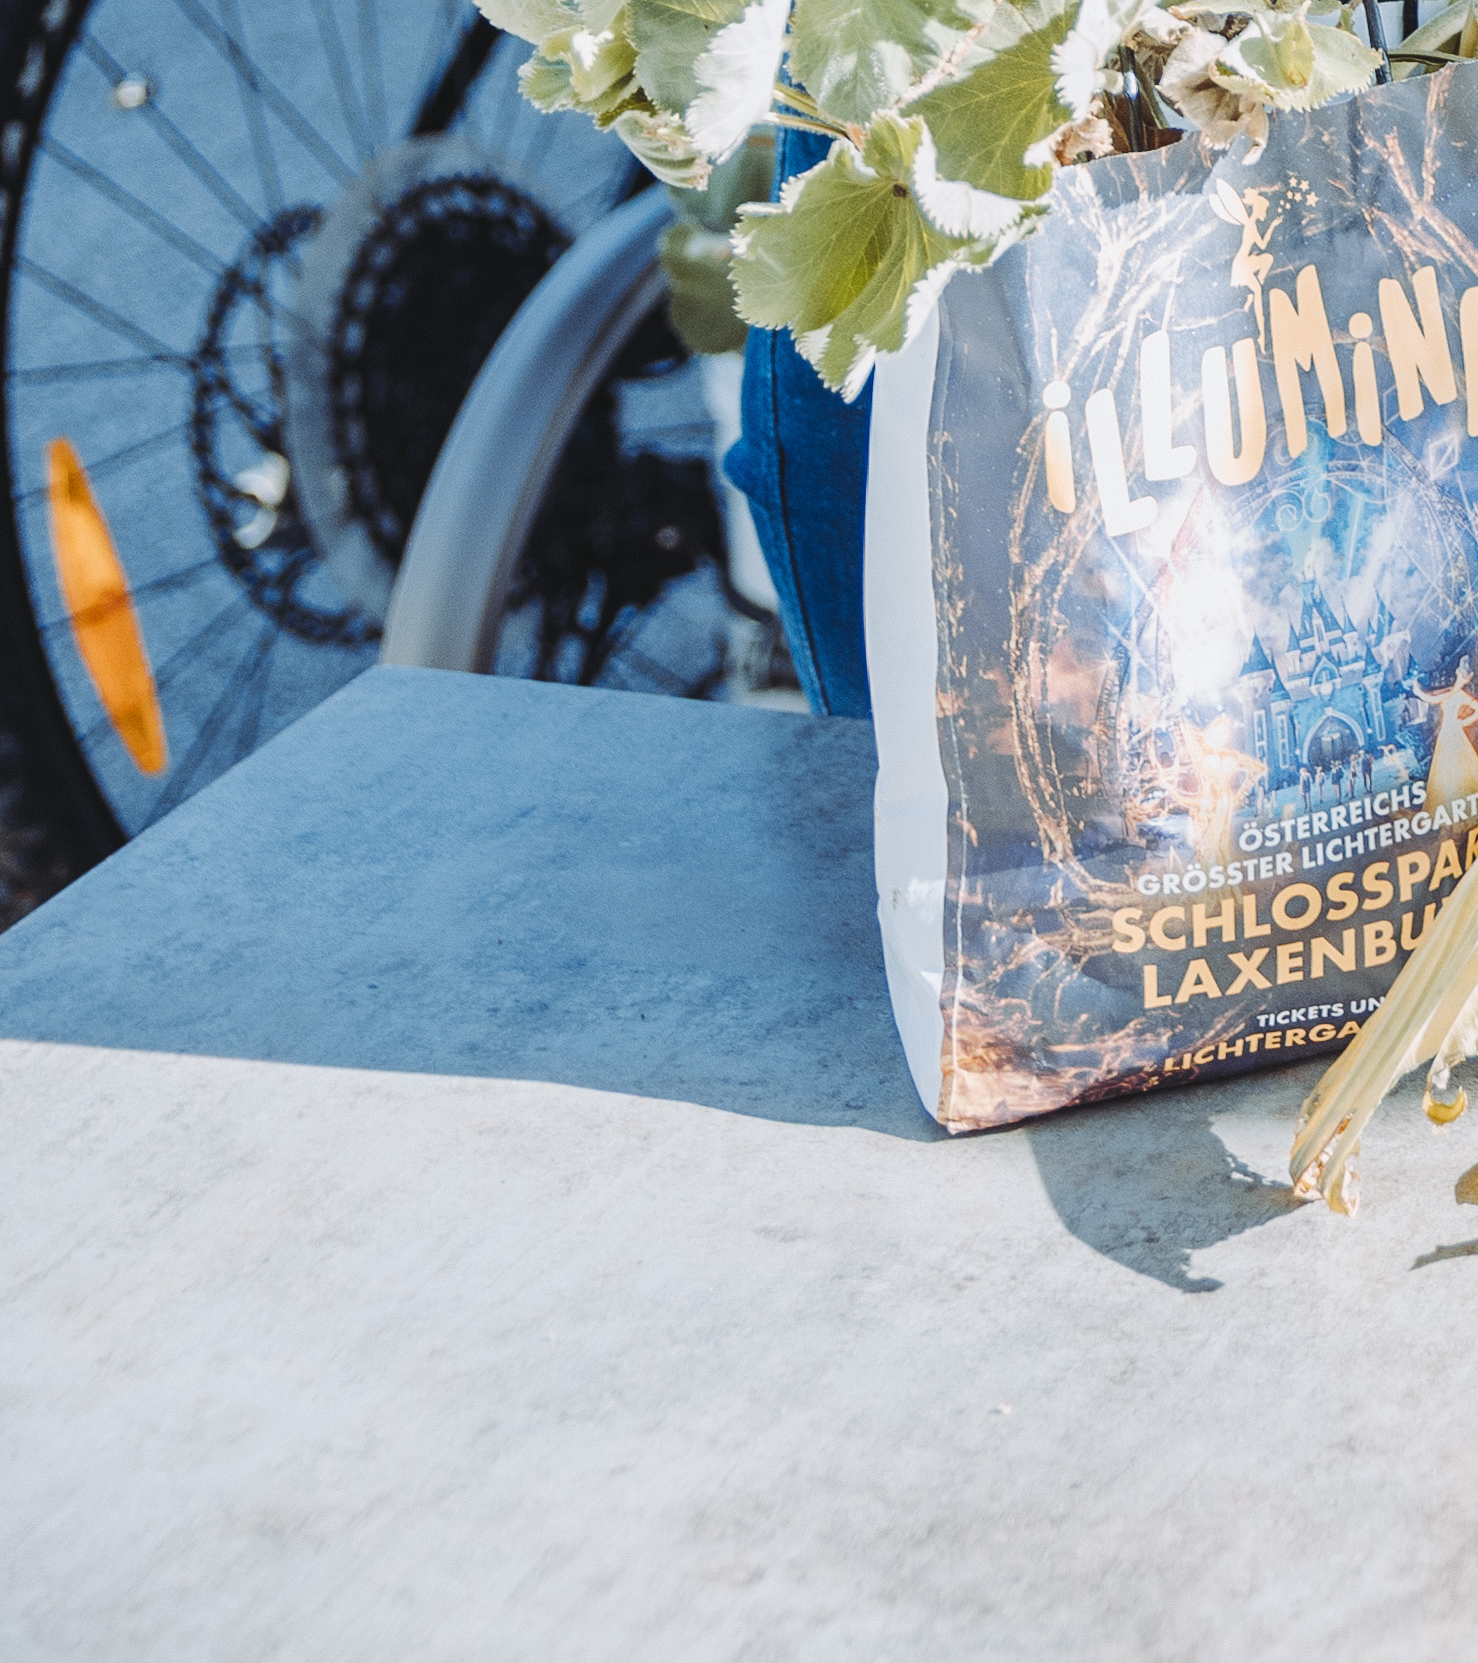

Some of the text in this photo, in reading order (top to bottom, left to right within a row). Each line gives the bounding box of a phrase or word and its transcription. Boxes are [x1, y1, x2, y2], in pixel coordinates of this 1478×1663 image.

[1238, 779, 1428, 852] ÖSTERREICHS
[1137, 852, 1294, 896] GRÖSSTER
[1142, 894, 1452, 1010] LAXENBU
[1256, 1002, 1345, 1028] TICKETS
